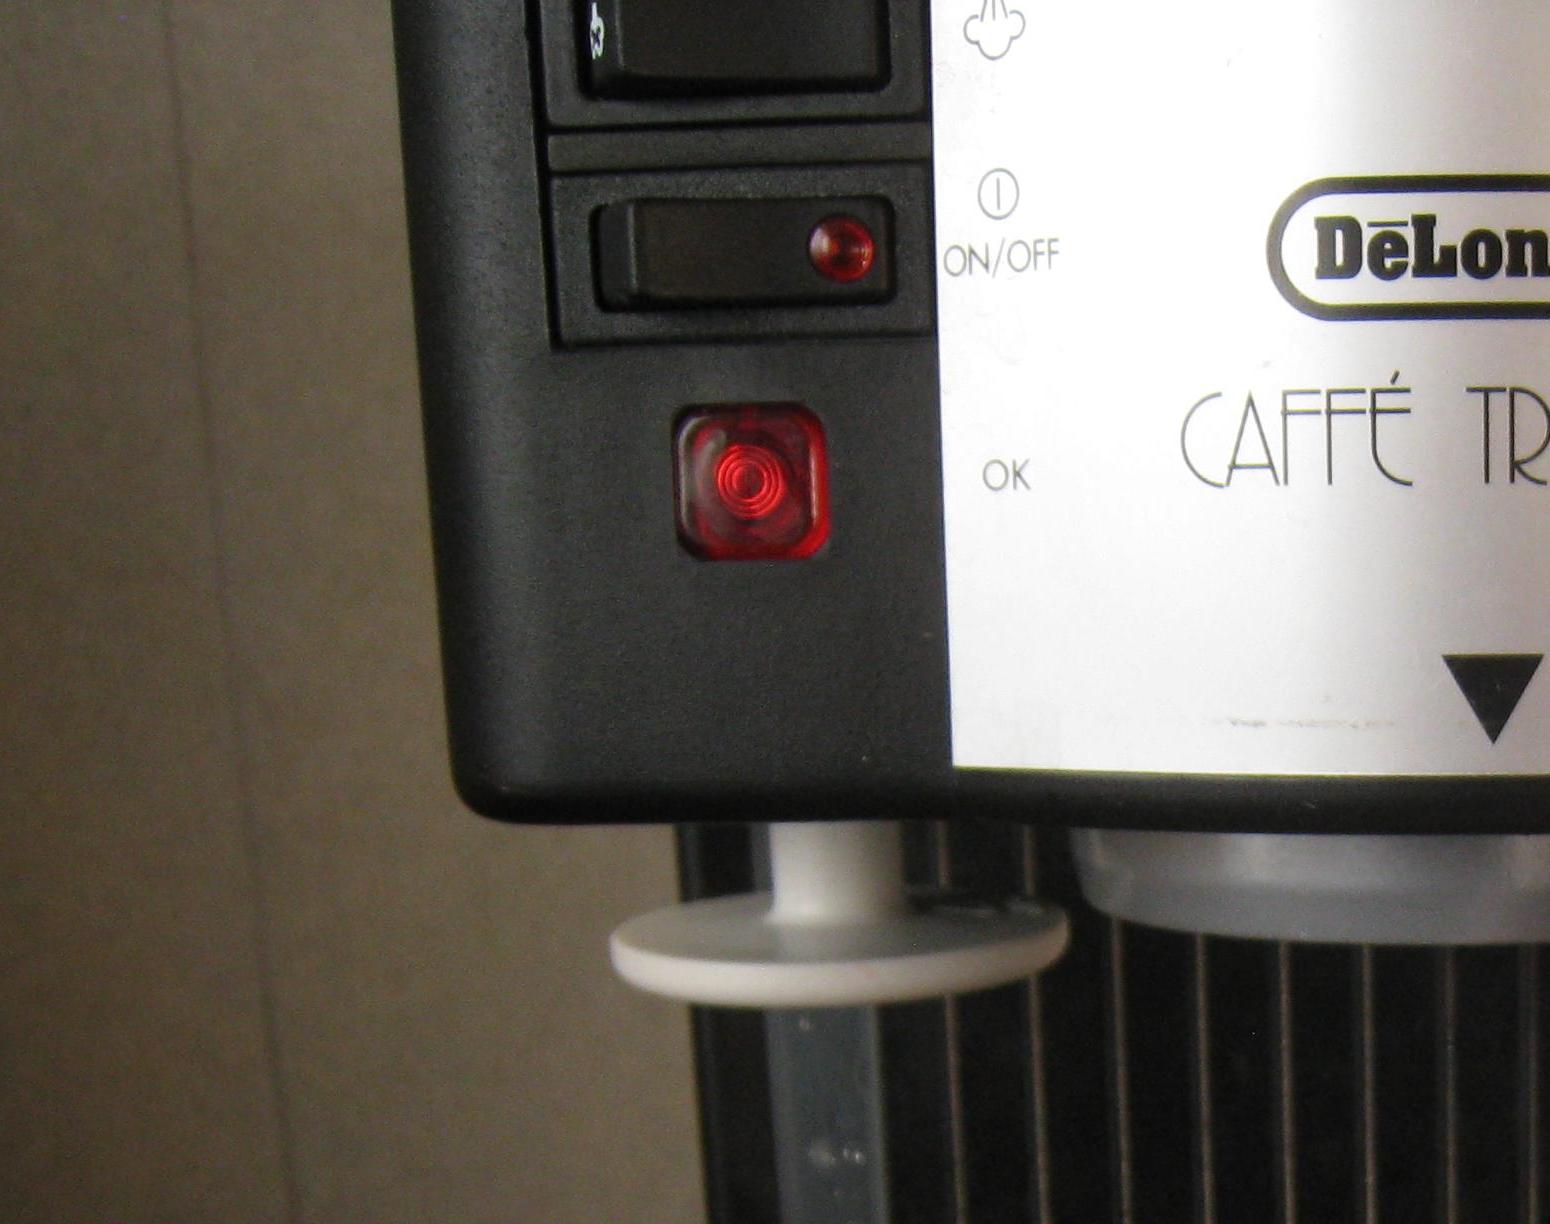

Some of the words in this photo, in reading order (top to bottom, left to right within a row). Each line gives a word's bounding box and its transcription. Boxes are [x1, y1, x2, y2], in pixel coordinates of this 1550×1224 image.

[943, 238, 1061, 279] ON/OFF
[1180, 370, 1414, 488] CAFFÉ
[982, 459, 1031, 493] OK
